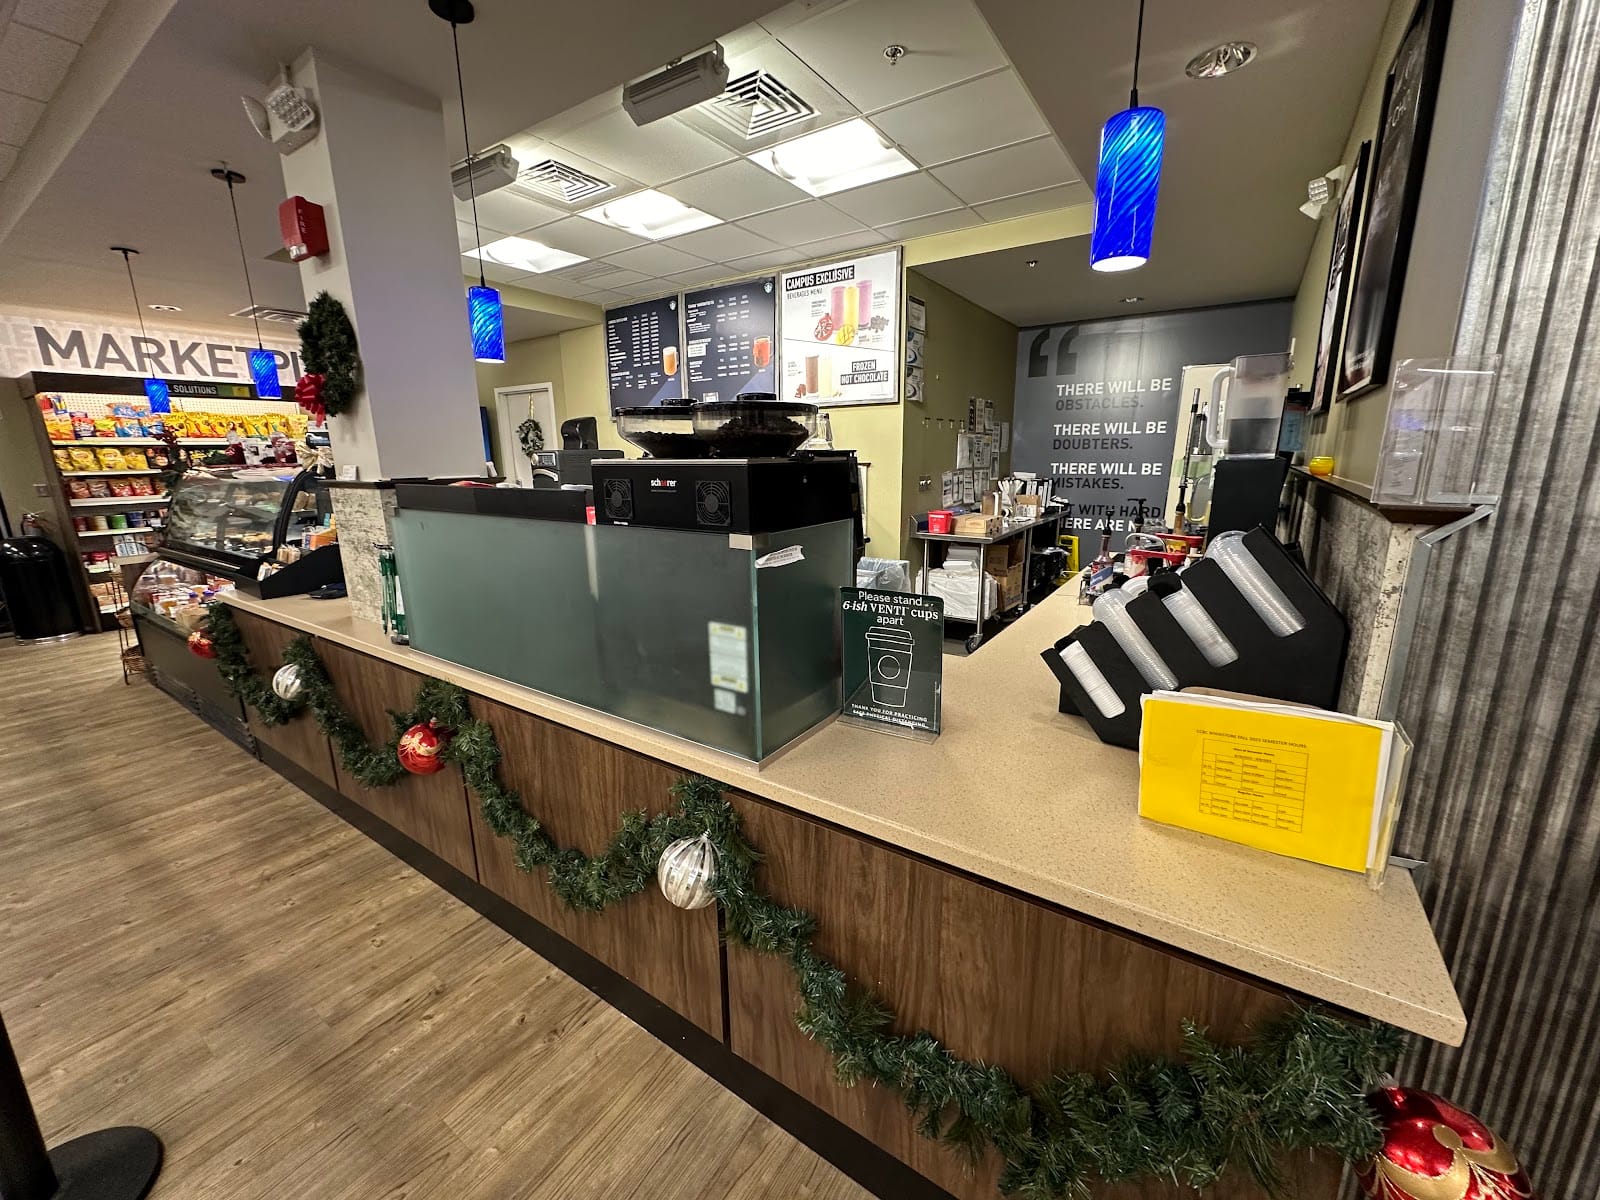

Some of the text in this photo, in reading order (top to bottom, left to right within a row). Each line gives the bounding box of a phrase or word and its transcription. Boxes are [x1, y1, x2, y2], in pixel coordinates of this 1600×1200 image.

[786, 267, 854, 290] CAMPUS EXCLUSIVE
[852, 360, 876, 372] FROZEN
[841, 371, 888, 385] HOT CHOCOLATE
[174, 384, 217, 395] SOLUTIONS
[1057, 378, 1172, 396] THERE WILL BE
[1055, 397, 1144, 411] OBSTACLES.
[1054, 421, 1167, 436] THERE WILL BE
[1053, 438, 1133, 450] DOUBTERS.
[1051, 463, 1162, 475] THERE WILL BE
[1051, 477, 1124, 490] MISTAKES.
[1119, 505, 1161, 518] HARD
[1094, 518, 1124, 532] ARE
[858, 591, 922, 607] Please stand
[842, 600, 868, 612] 6-ish
[911, 609, 939, 621] cups
[876, 615, 904, 625] apart
